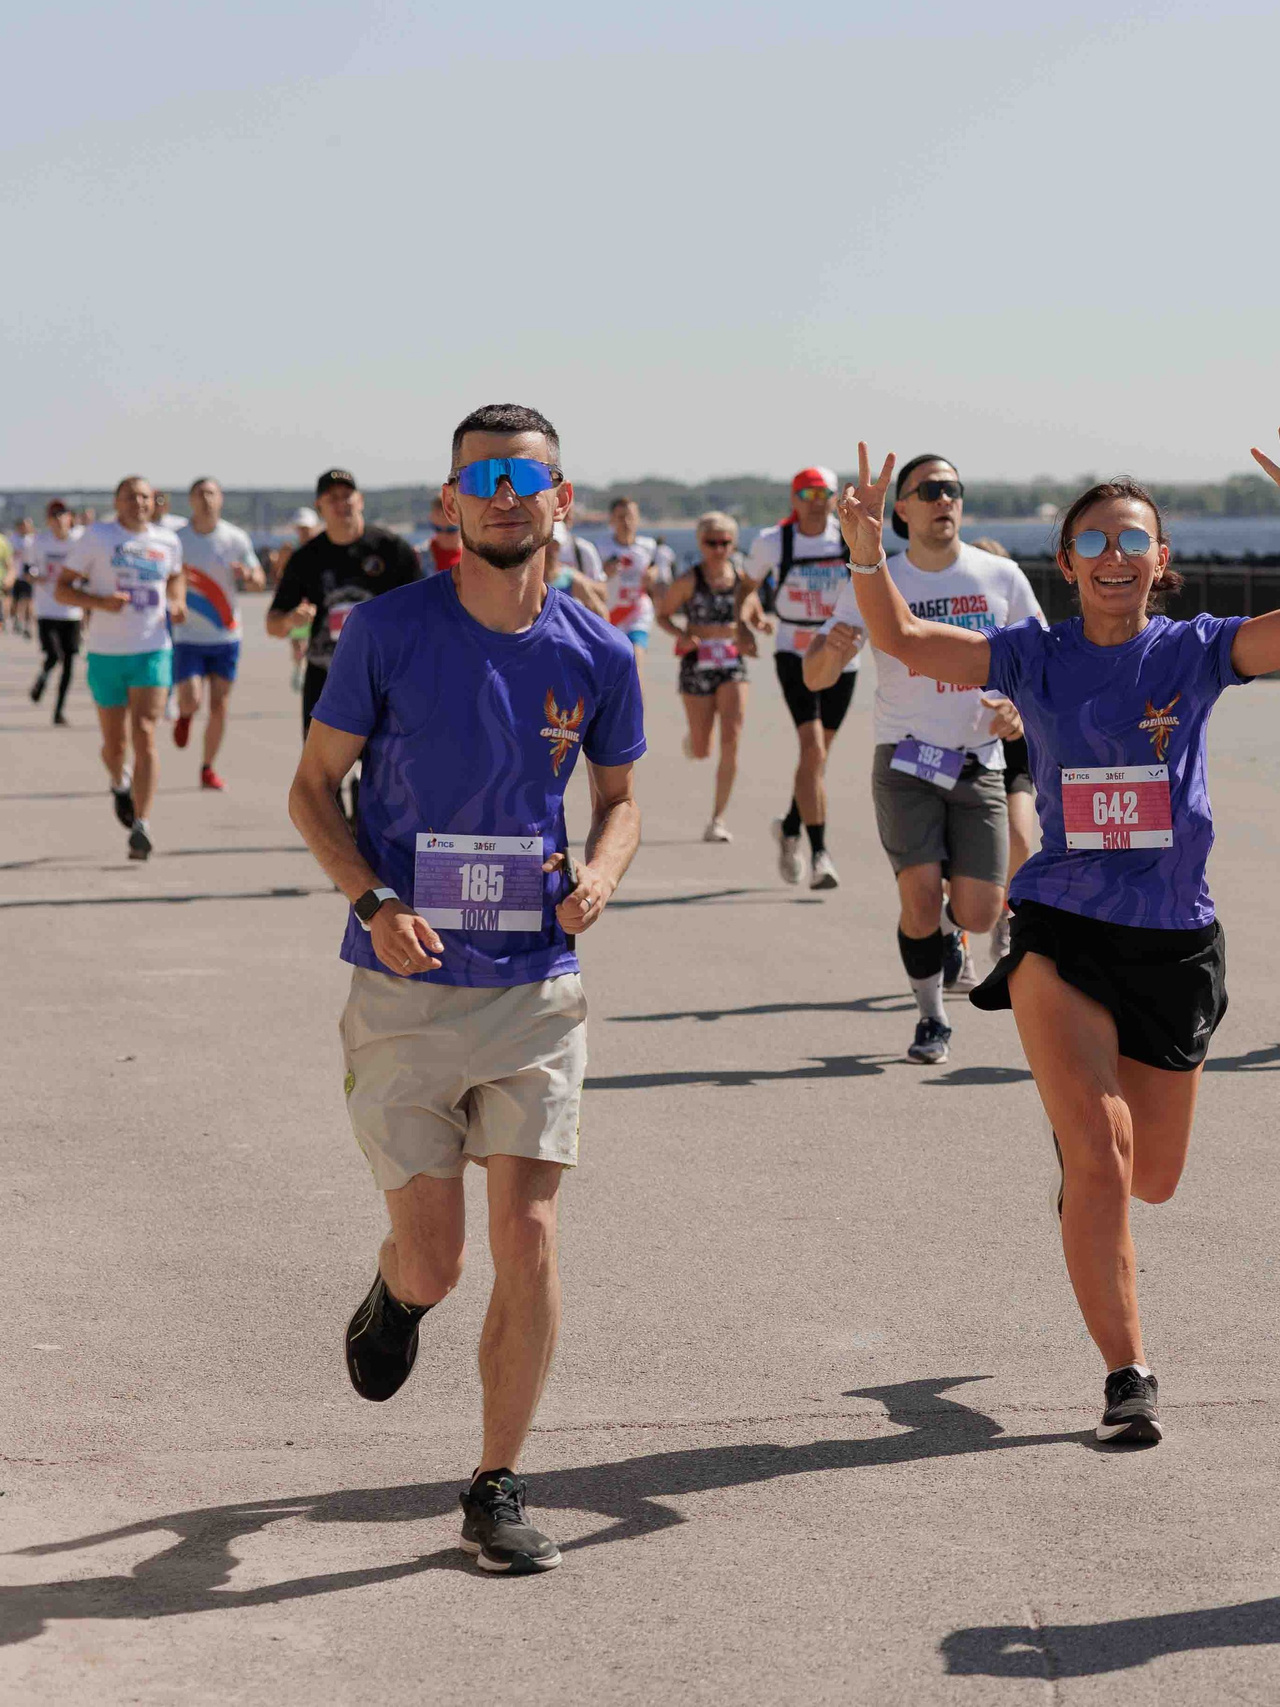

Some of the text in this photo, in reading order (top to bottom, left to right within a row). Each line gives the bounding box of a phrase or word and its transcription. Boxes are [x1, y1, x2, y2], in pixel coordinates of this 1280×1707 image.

[917, 744, 944, 769] 192
[1092, 791, 1139, 826] 642
[437, 841, 454, 849] ПСБ
[458, 863, 504, 903] 185
